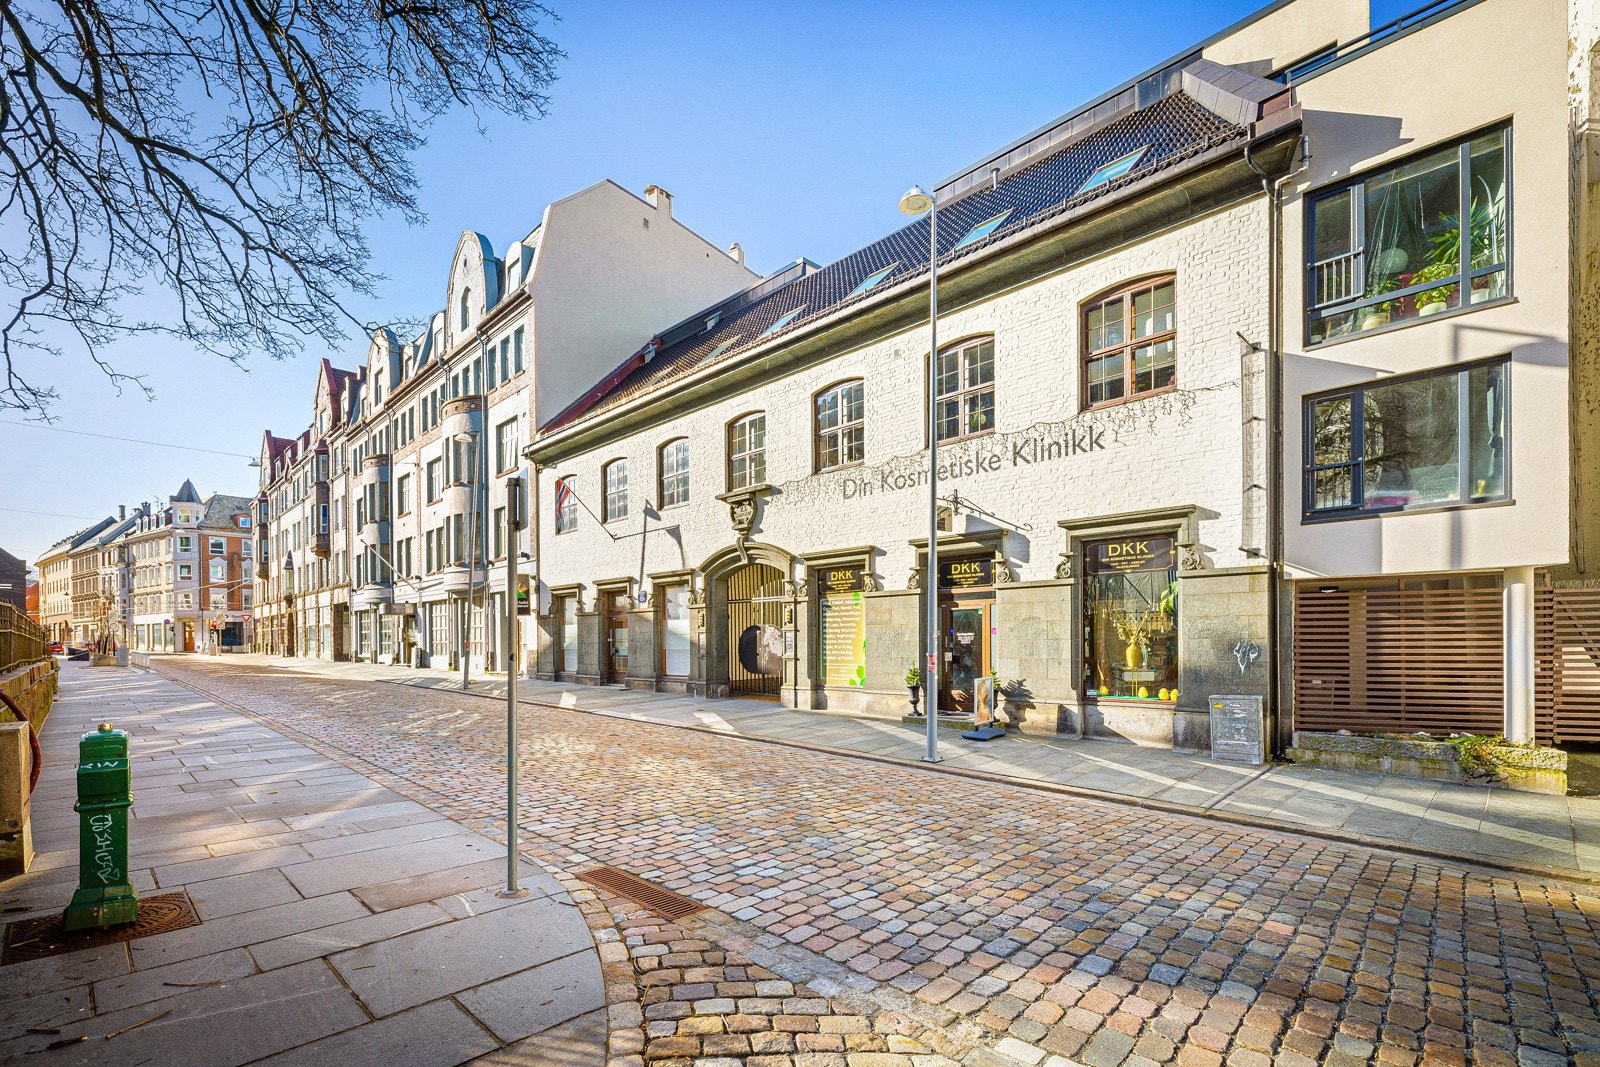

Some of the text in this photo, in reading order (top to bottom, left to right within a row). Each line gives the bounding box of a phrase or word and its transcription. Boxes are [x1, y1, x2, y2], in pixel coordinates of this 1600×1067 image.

[842, 426, 1106, 500] Din Kosmetiske Klinikk
[1108, 541, 1149, 557] DKK
[951, 562, 981, 574] DKK
[831, 570, 853, 581] DKK
